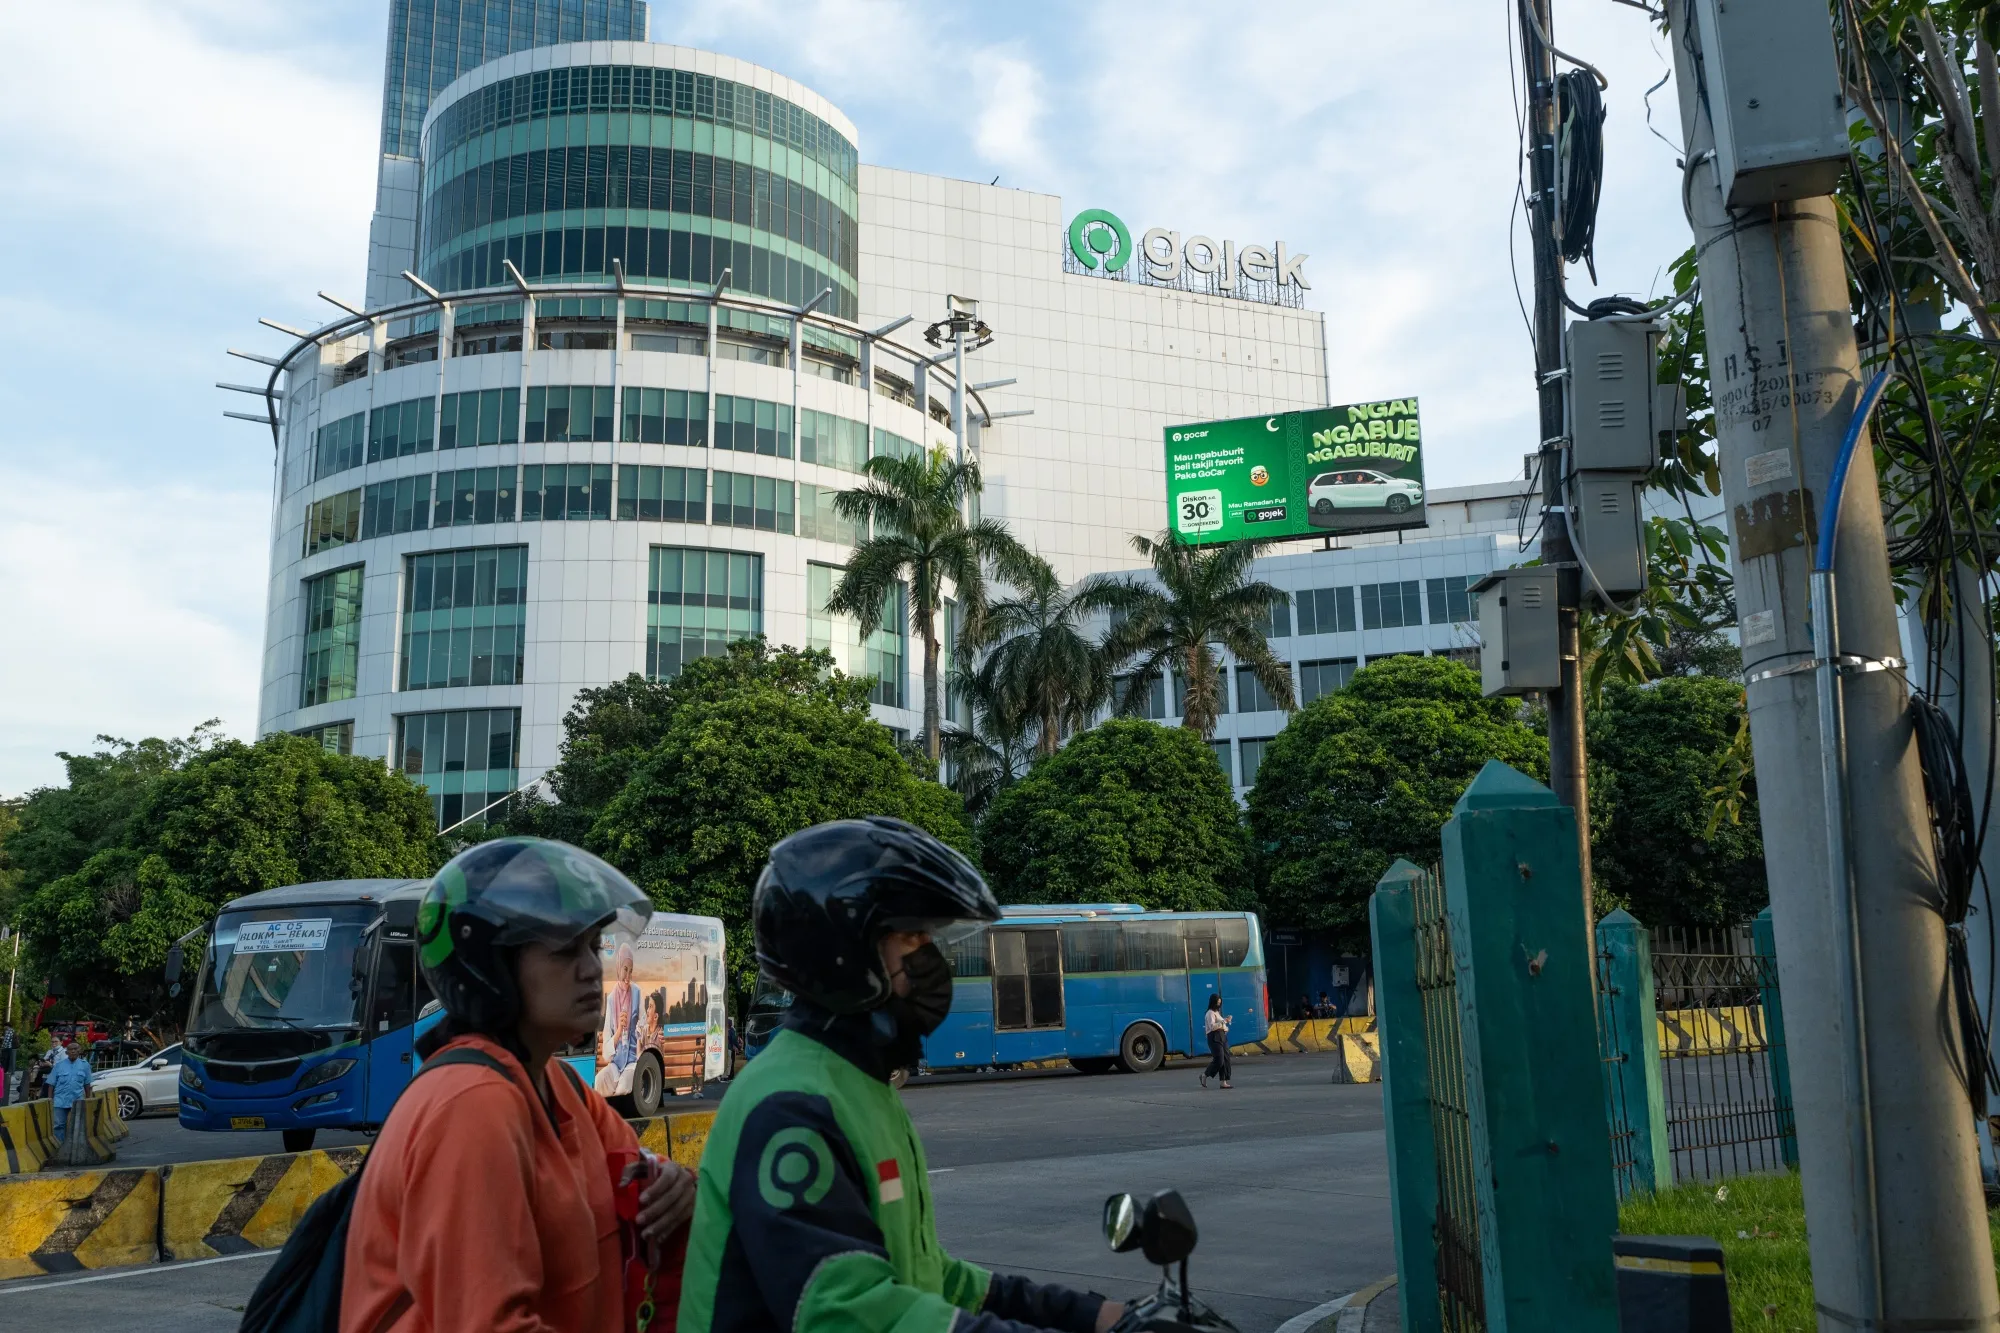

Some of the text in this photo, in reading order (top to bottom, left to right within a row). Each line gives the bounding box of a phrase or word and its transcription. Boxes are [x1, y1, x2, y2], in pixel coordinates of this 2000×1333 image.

[1143, 227, 1312, 290] gojek
[1752, 415, 1772, 432] 07
[1183, 430, 1209, 441] gocar
[1174, 447, 1244, 462] Mau ngabuburit
[1306, 442, 1418, 465] NGABUBURIT
[1174, 456, 1244, 471] beli takjil favorit
[1175, 469, 1226, 480] Pake GoCar
[1243, 499, 1273, 507] Ramadan
[1182, 502, 1209, 520] 30
[1258, 509, 1283, 520] gojek
[268, 923, 281, 931] AC
[289, 929, 326, 938] BEKASI
